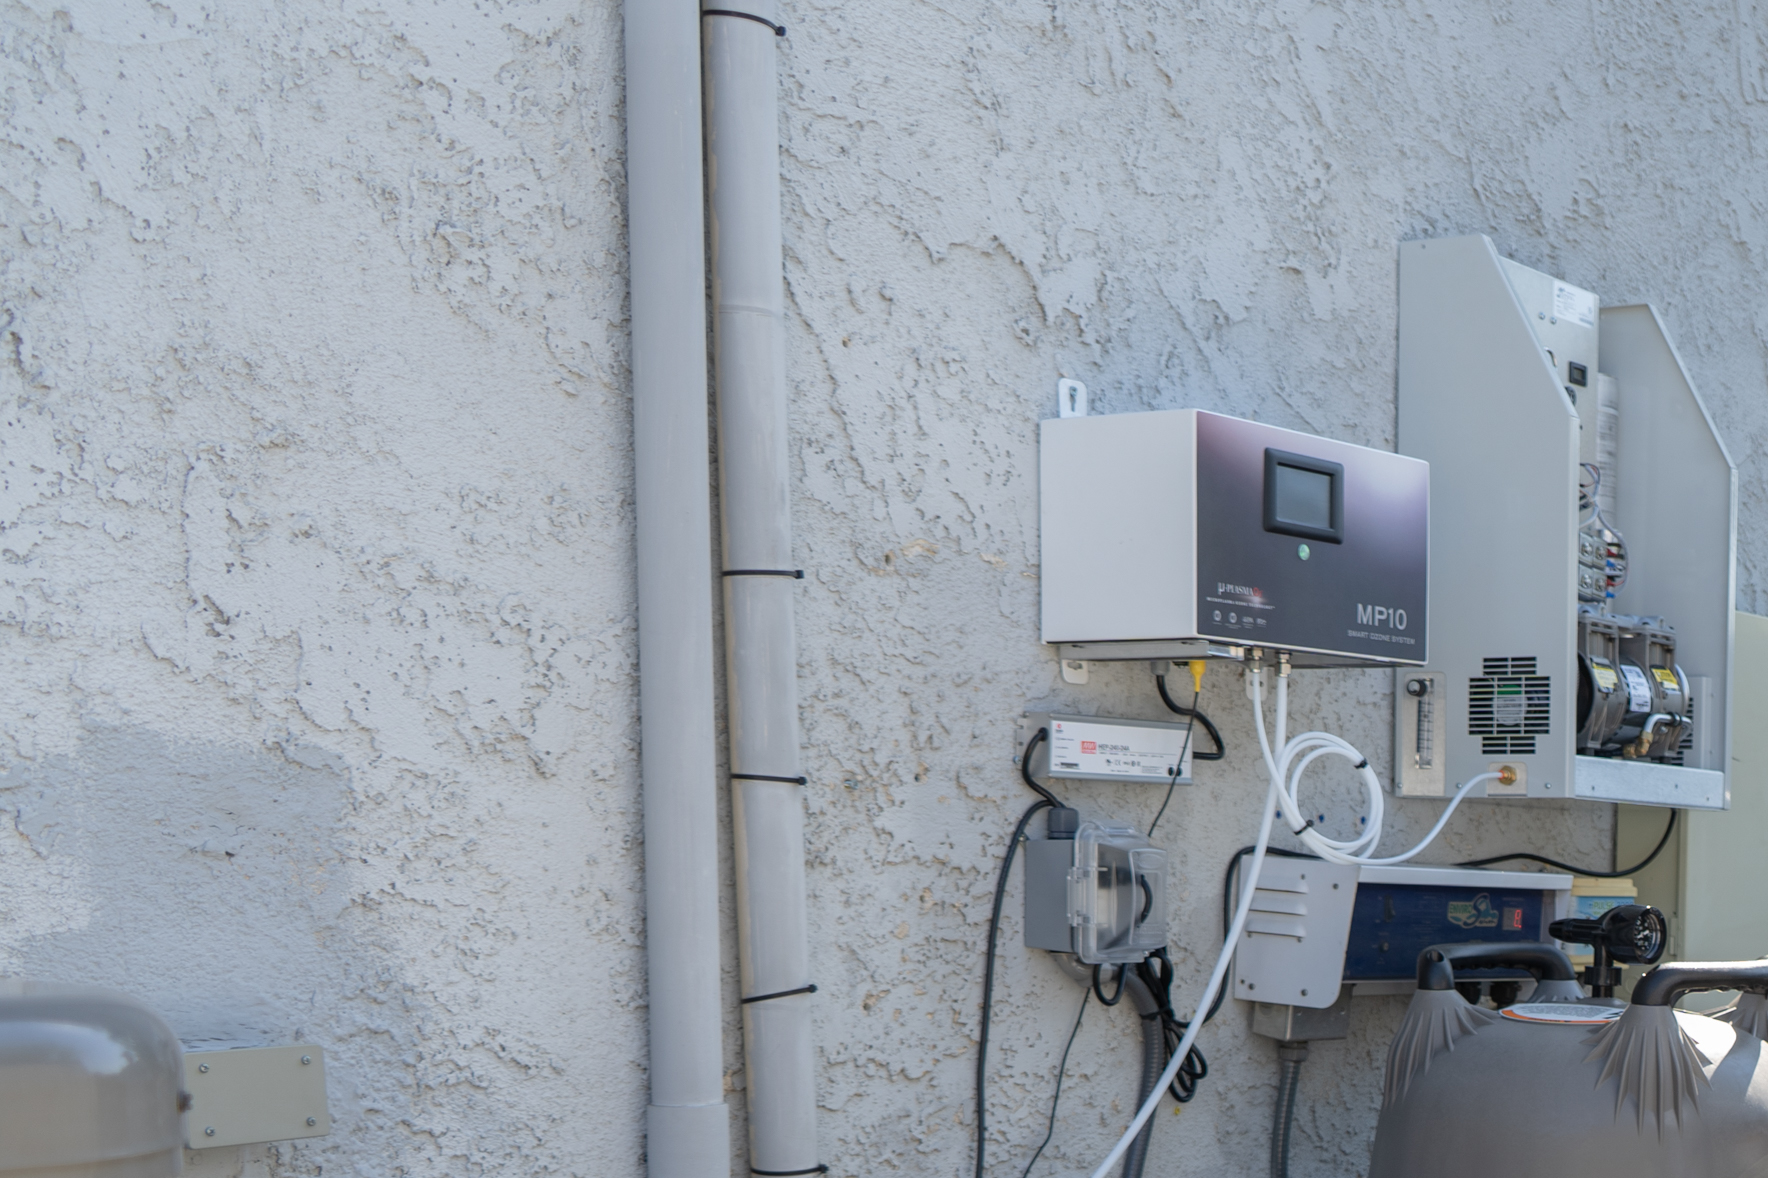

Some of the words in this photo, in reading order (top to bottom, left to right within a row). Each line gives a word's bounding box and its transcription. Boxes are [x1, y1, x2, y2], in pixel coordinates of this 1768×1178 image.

[1356, 602, 1408, 631] MP10
[1347, 629, 1369, 639] SMART
[1370, 632, 1391, 642] OZONE
[1391, 635, 1416, 645] SYSTEM
